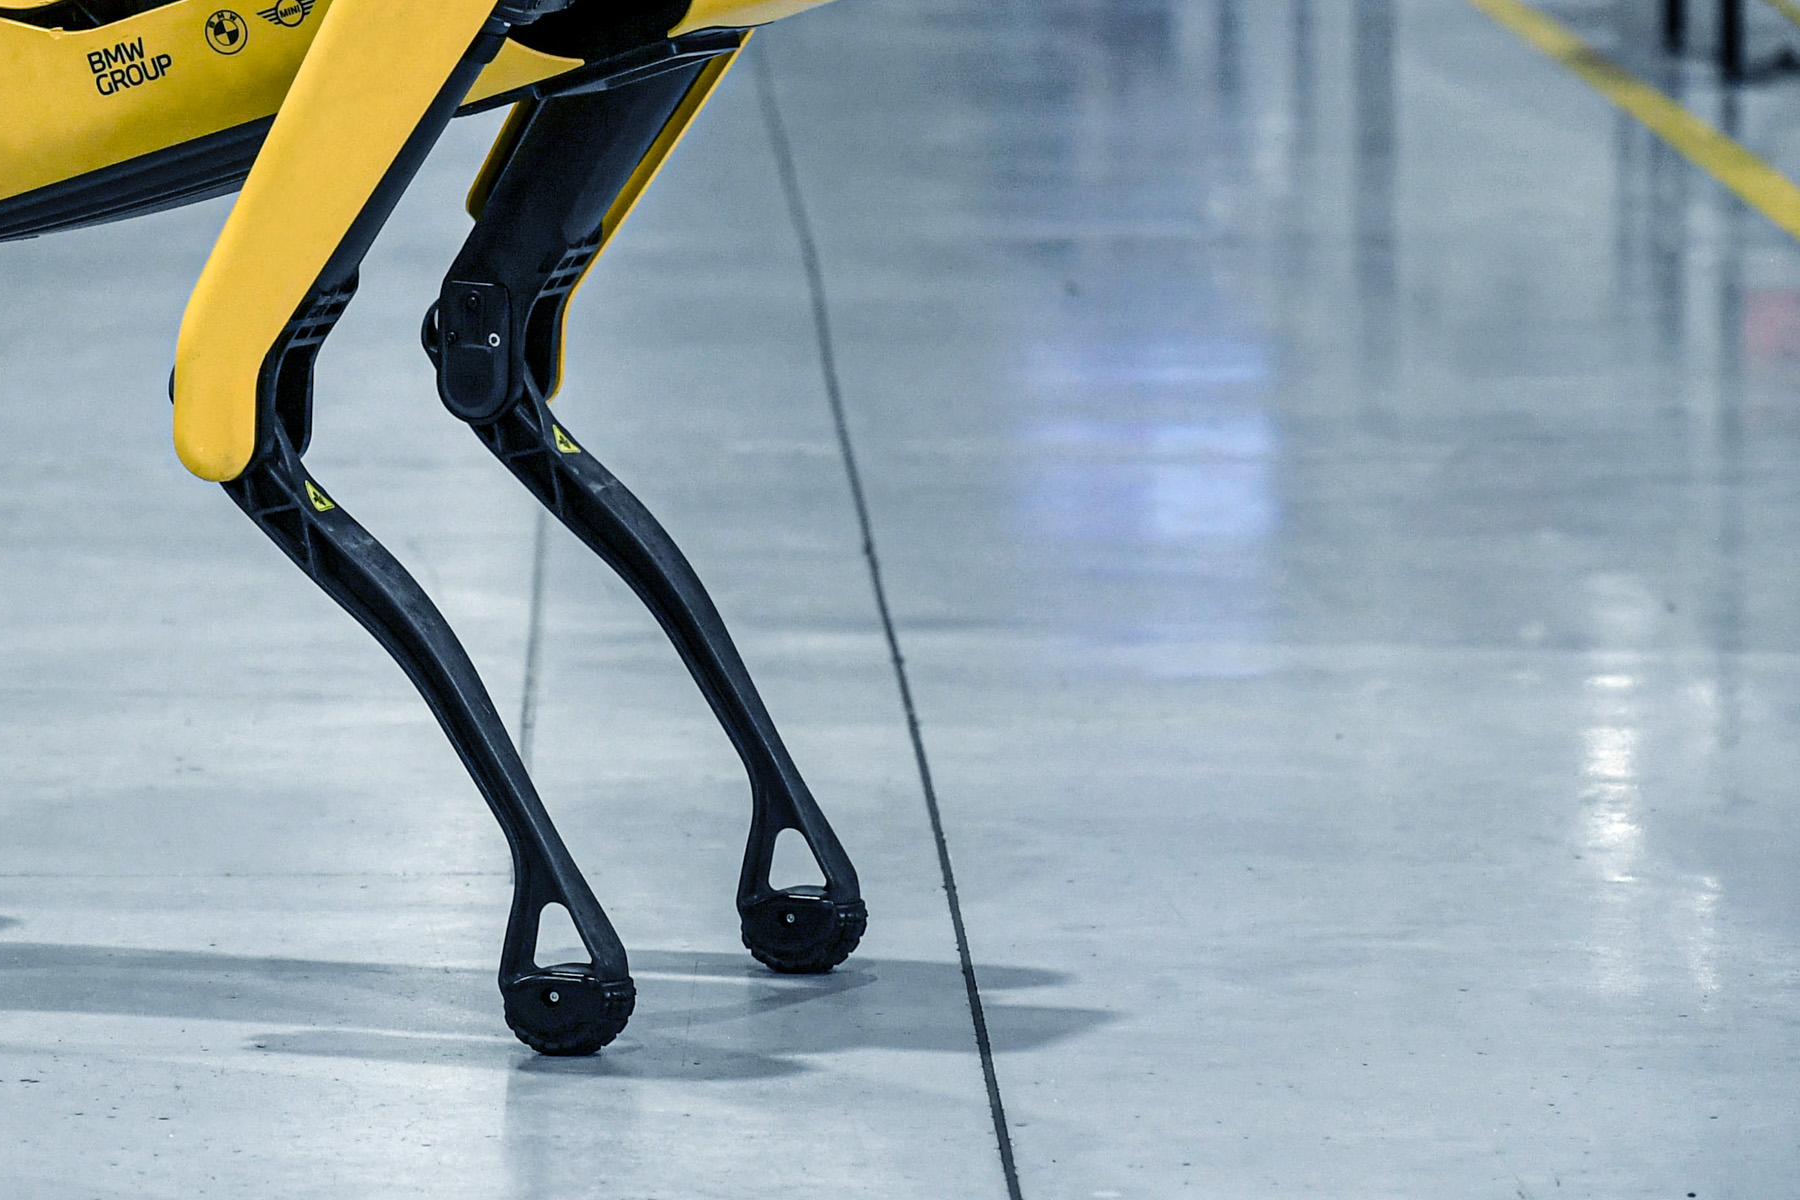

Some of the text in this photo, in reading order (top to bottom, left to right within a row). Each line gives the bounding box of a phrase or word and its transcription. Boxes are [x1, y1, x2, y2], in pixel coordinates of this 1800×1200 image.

[279, 4, 301, 18] MINI
[86, 36, 145, 74] BMW
[96, 53, 172, 96] GROUP
